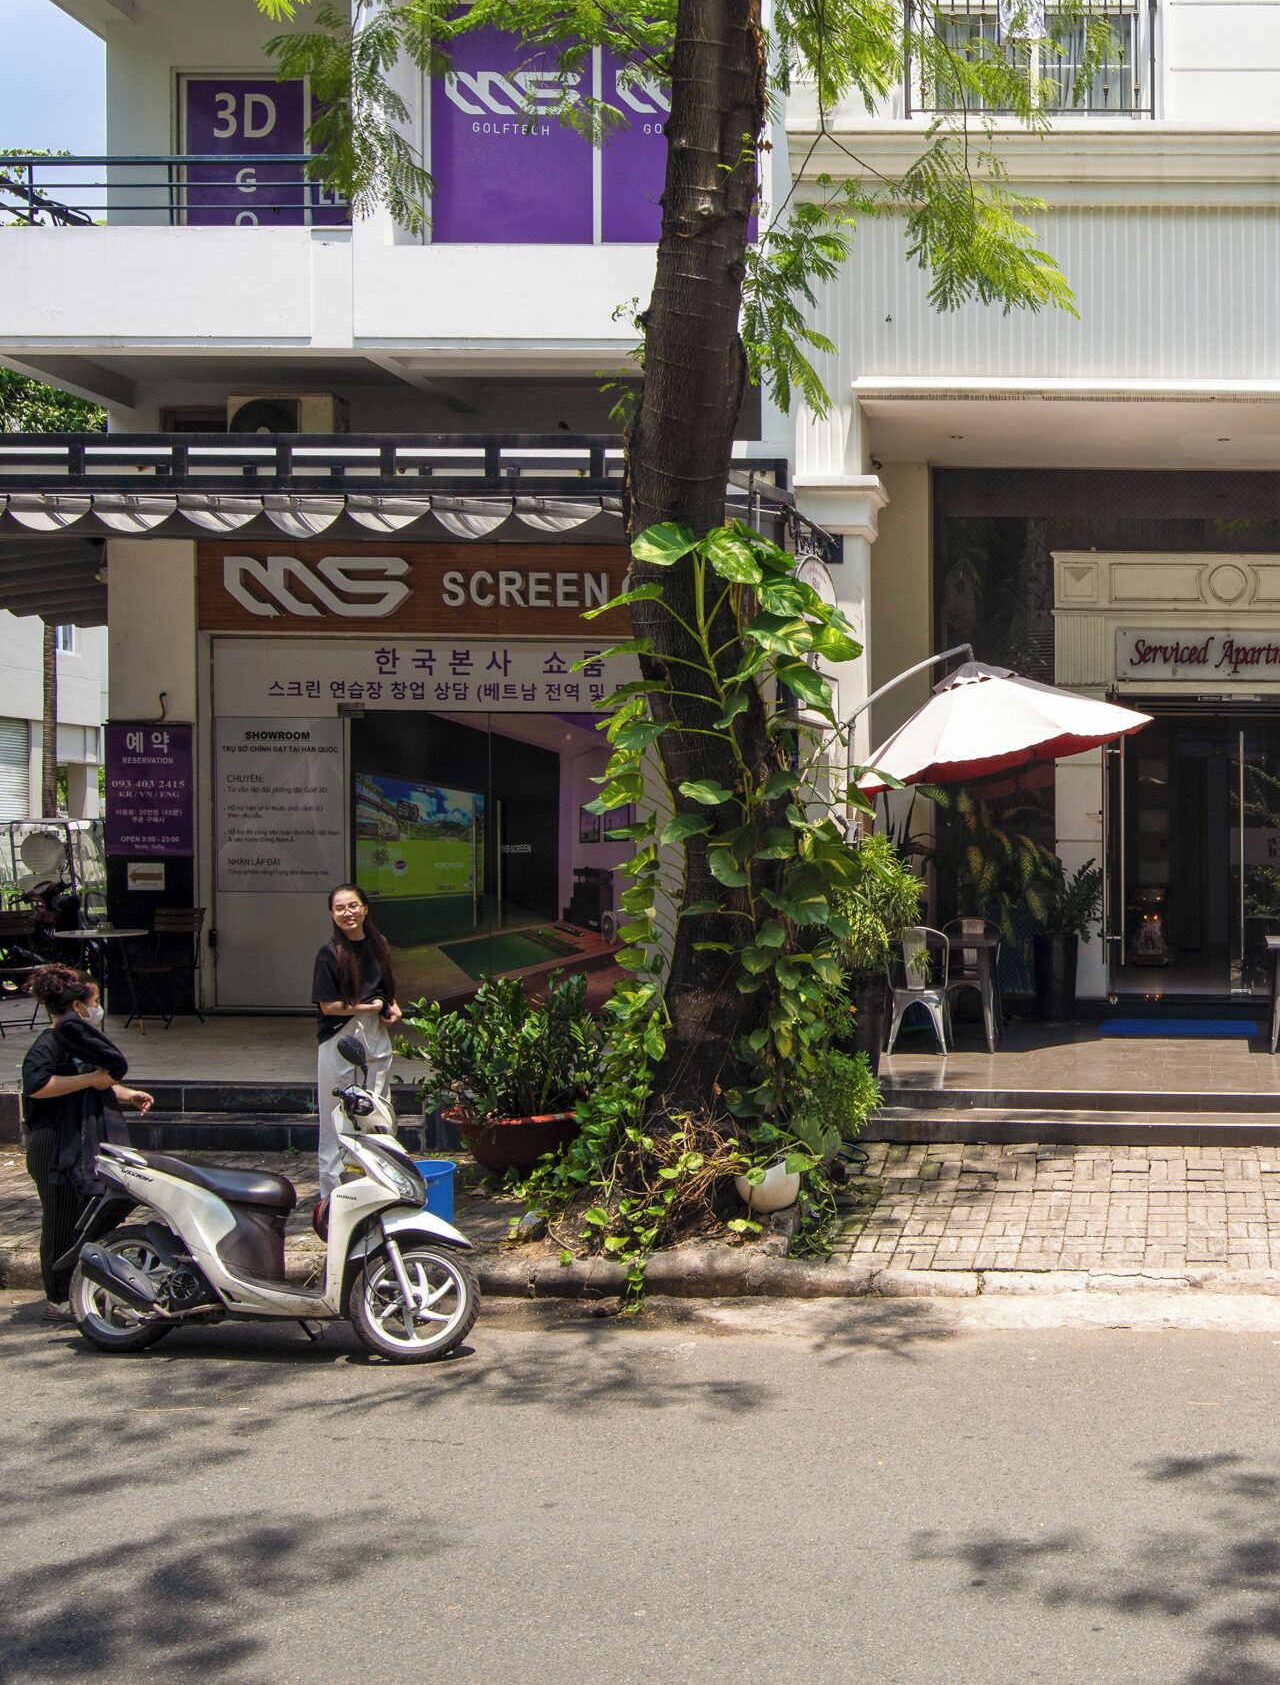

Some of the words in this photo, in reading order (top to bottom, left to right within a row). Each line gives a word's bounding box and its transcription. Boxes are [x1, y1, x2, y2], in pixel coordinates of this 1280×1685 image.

[213, 92, 277, 138] 3D
[473, 121, 550, 136] GOLFTECH
[442, 570, 609, 608] SCREEN
[1130, 637, 1215, 665] Serviced
[268, 680, 321, 699] 스크린
[329, 680, 383, 700] 연습장
[391, 680, 426, 701] 창업
[434, 681, 469, 701] 상담
[545, 682, 580, 702] 전역
[245, 731, 310, 740] SHOWROOM
[122, 756, 174, 764] RESERVATION
[111, 779, 132, 789] 093
[135, 779, 155, 789] 403
[159, 779, 185, 789] 2415
[121, 1168, 154, 1182] VISION
